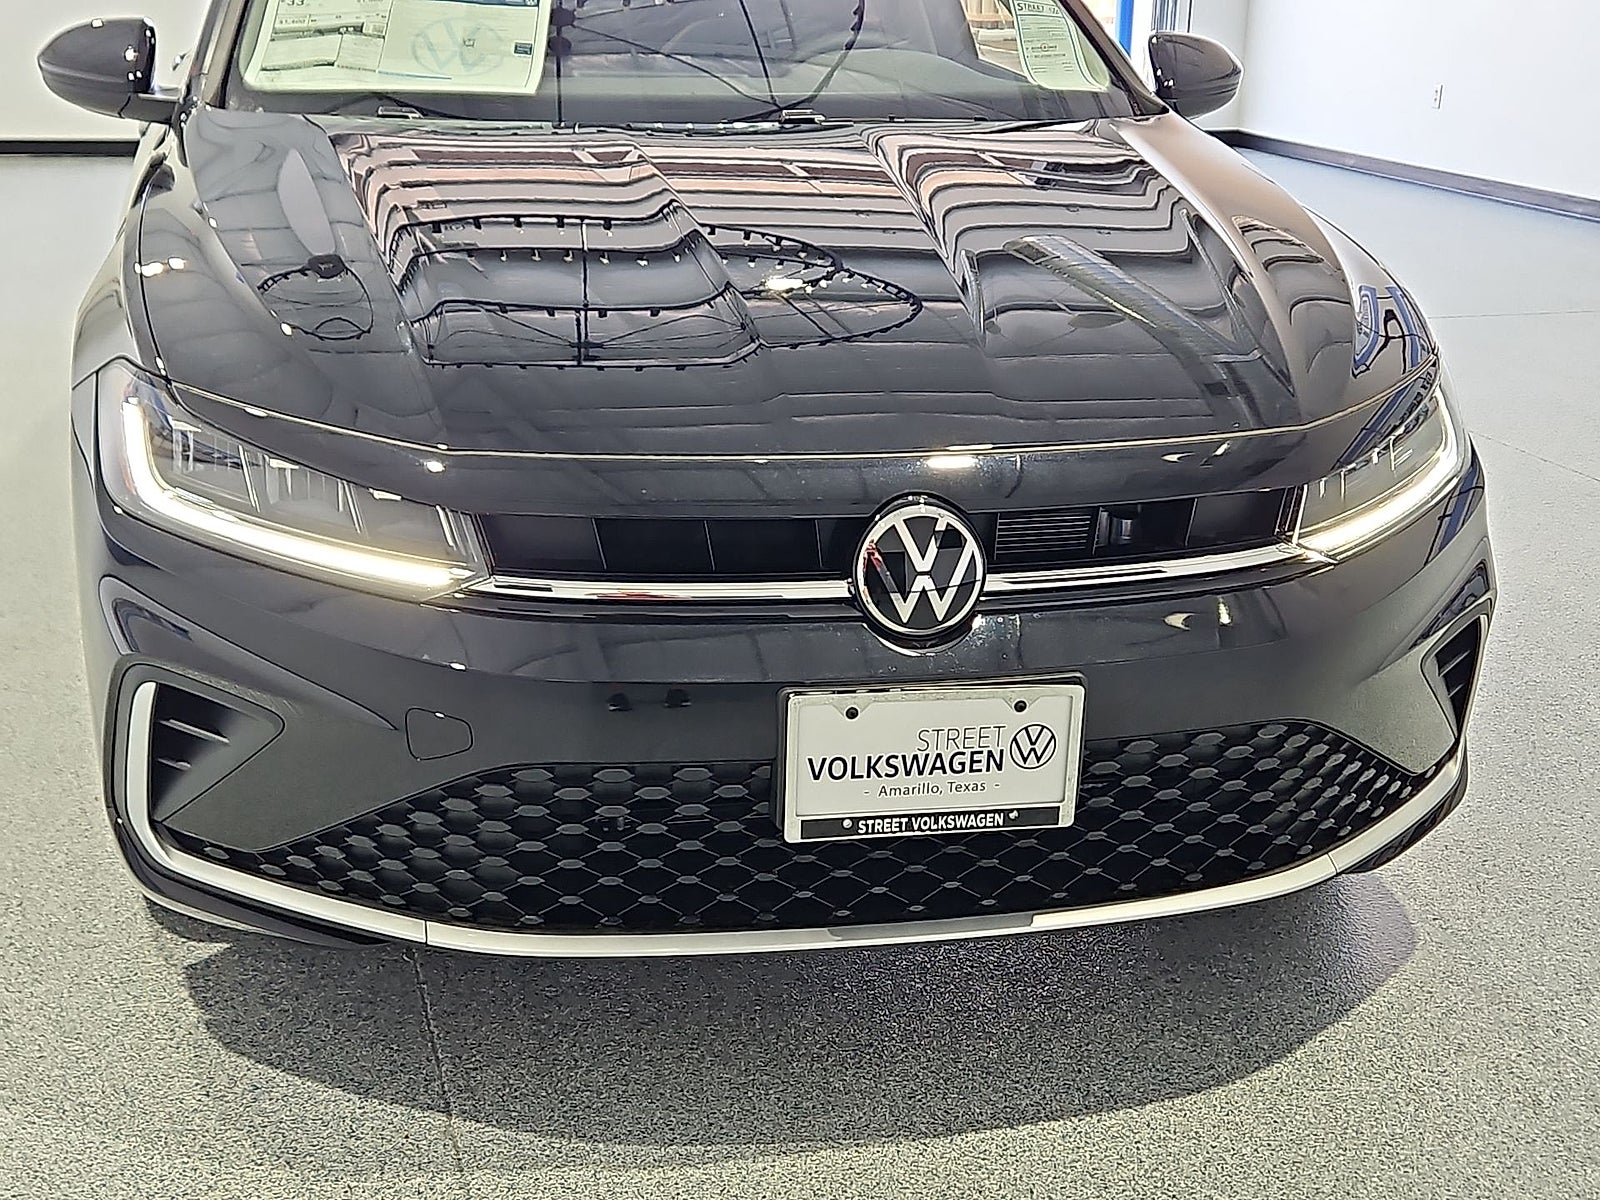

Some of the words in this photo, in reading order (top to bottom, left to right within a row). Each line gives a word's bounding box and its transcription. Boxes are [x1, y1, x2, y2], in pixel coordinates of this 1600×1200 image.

[857, 505, 984, 635] VW
[917, 725, 1006, 752] STREET
[1010, 724, 1056, 770] VW
[807, 749, 1005, 781] VOLKSWAGEN
[878, 782, 943, 798] Amarillo,
[948, 781, 986, 793] Texas
[858, 817, 907, 834] STREET
[912, 813, 1004, 831] VOLKSWAGEN
